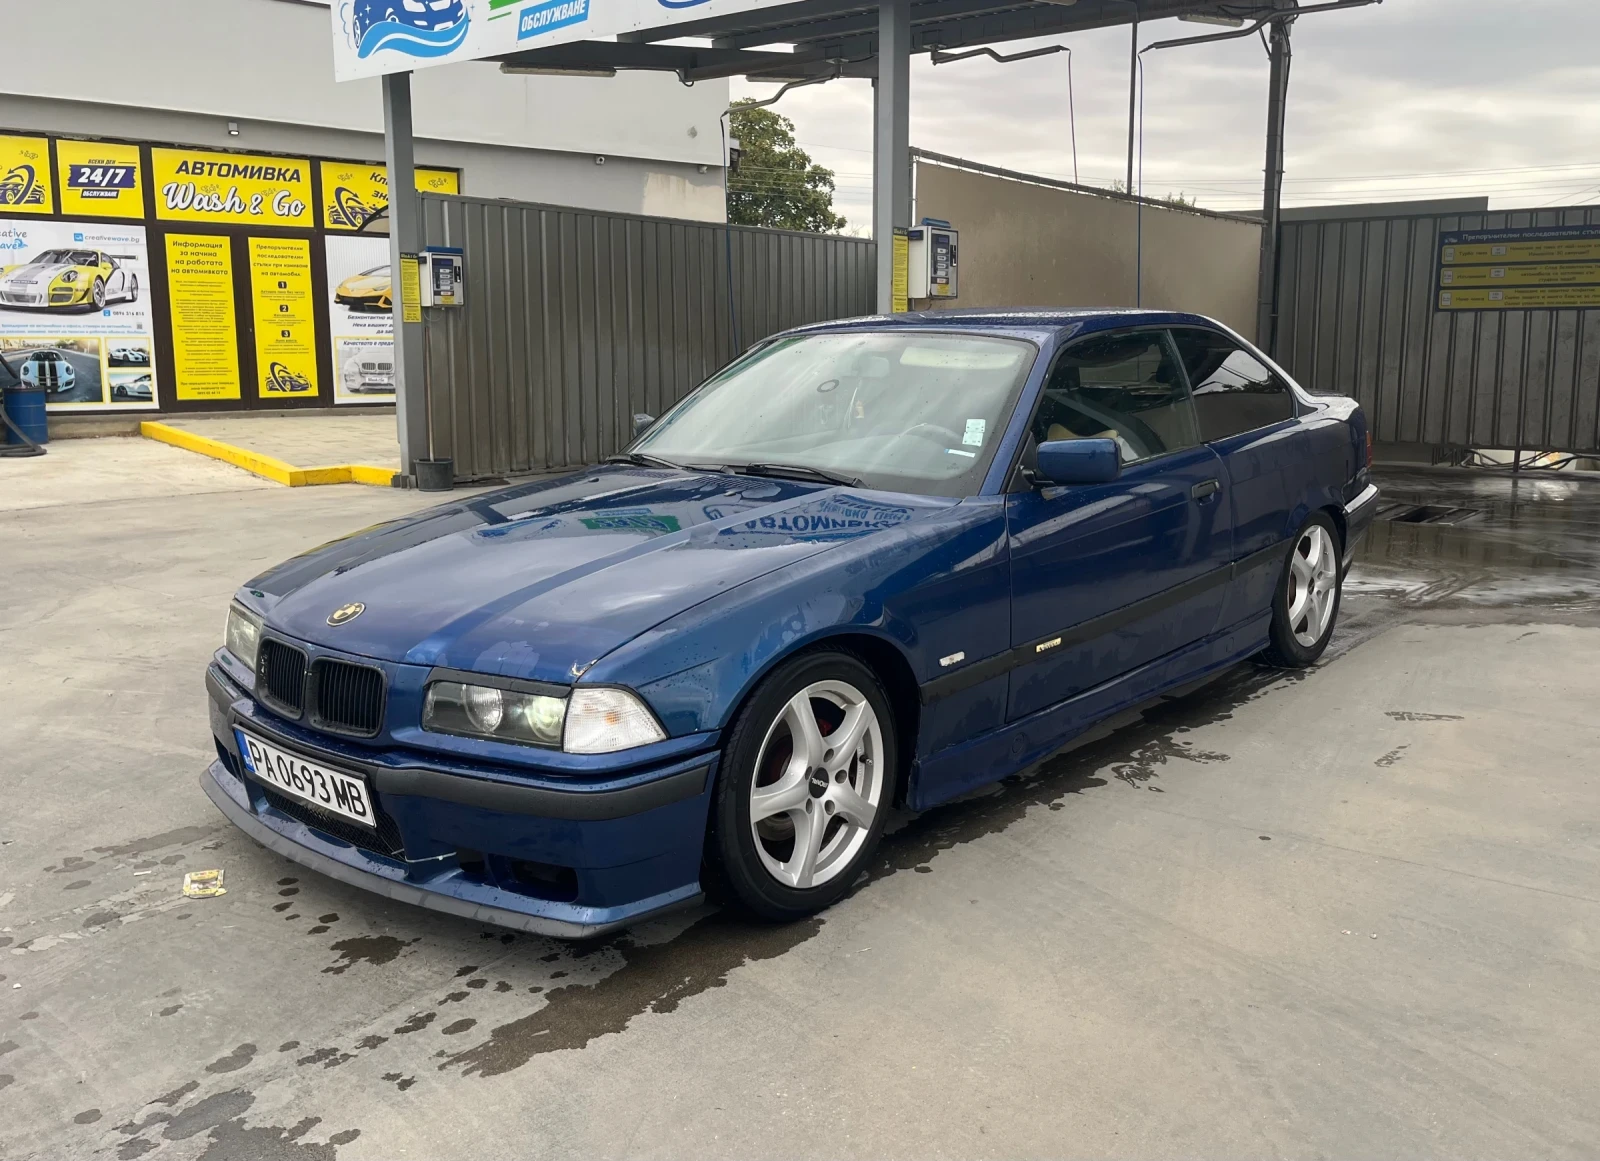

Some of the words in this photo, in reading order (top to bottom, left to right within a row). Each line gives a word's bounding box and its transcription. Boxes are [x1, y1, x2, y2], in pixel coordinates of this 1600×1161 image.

[521, 0, 586, 32] ОБСЛУЖВАНЕ
[78, 167, 125, 187] 24/7
[175, 160, 301, 183] АВТОМИВКА
[162, 181, 246, 214] Wash
[249, 193, 264, 215] &
[271, 189, 305, 217] Go
[0, 227, 27, 238] ative
[84, 235, 140, 243] creativewave.bg
[1462, 233, 1520, 243] Препоръчителни
[1522, 231, 1580, 239] последователни
[172, 241, 223, 249] Информация
